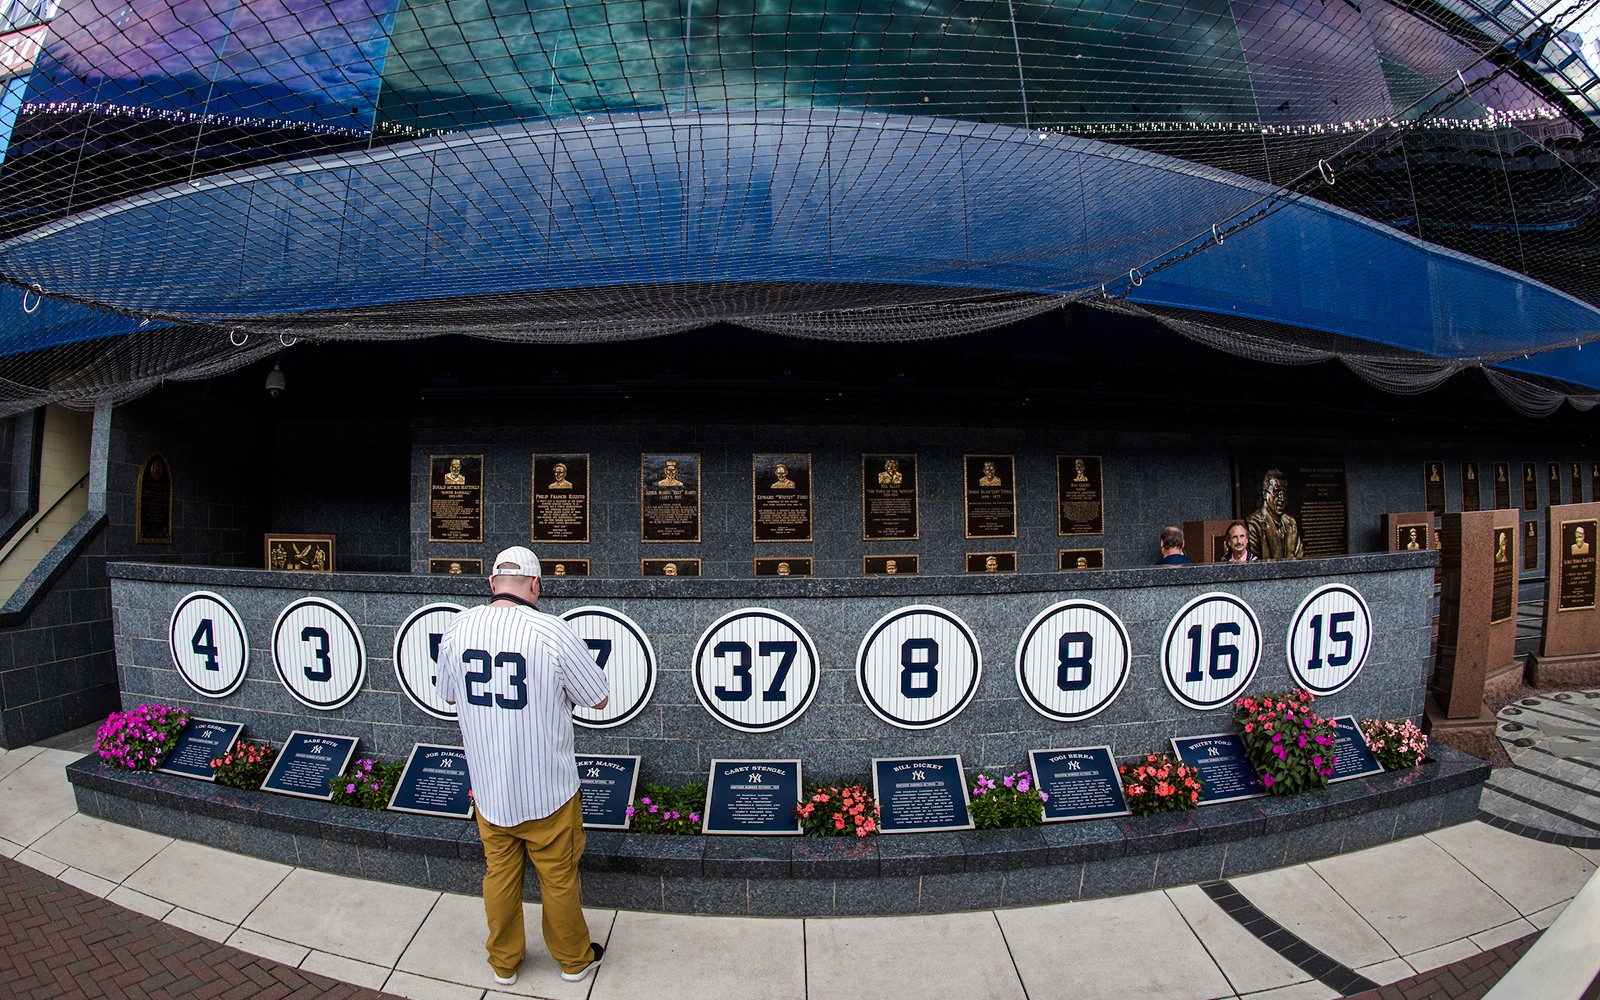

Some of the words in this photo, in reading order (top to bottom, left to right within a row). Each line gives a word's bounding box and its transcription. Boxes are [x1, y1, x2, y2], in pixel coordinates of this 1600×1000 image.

[192, 619, 219, 671] 4
[301, 627, 331, 682] 3
[1057, 632, 1093, 691] 8
[1186, 622, 1241, 682] 16
[1308, 612, 1354, 669] 15
[463, 649, 528, 709] 23
[714, 641, 797, 701] 37
[901, 638, 939, 698] 8
[207, 724, 227, 733] GEHRIG
[321, 739, 338, 748] RUTH
[1188, 740, 1212, 750] WHITEY
[595, 760, 626, 772] MANTLE
[724, 766, 750, 776] CASEY
[751, 765, 786, 776] STENGEL
[893, 764, 912, 772] BILL
[1049, 754, 1067, 763] YOGI
